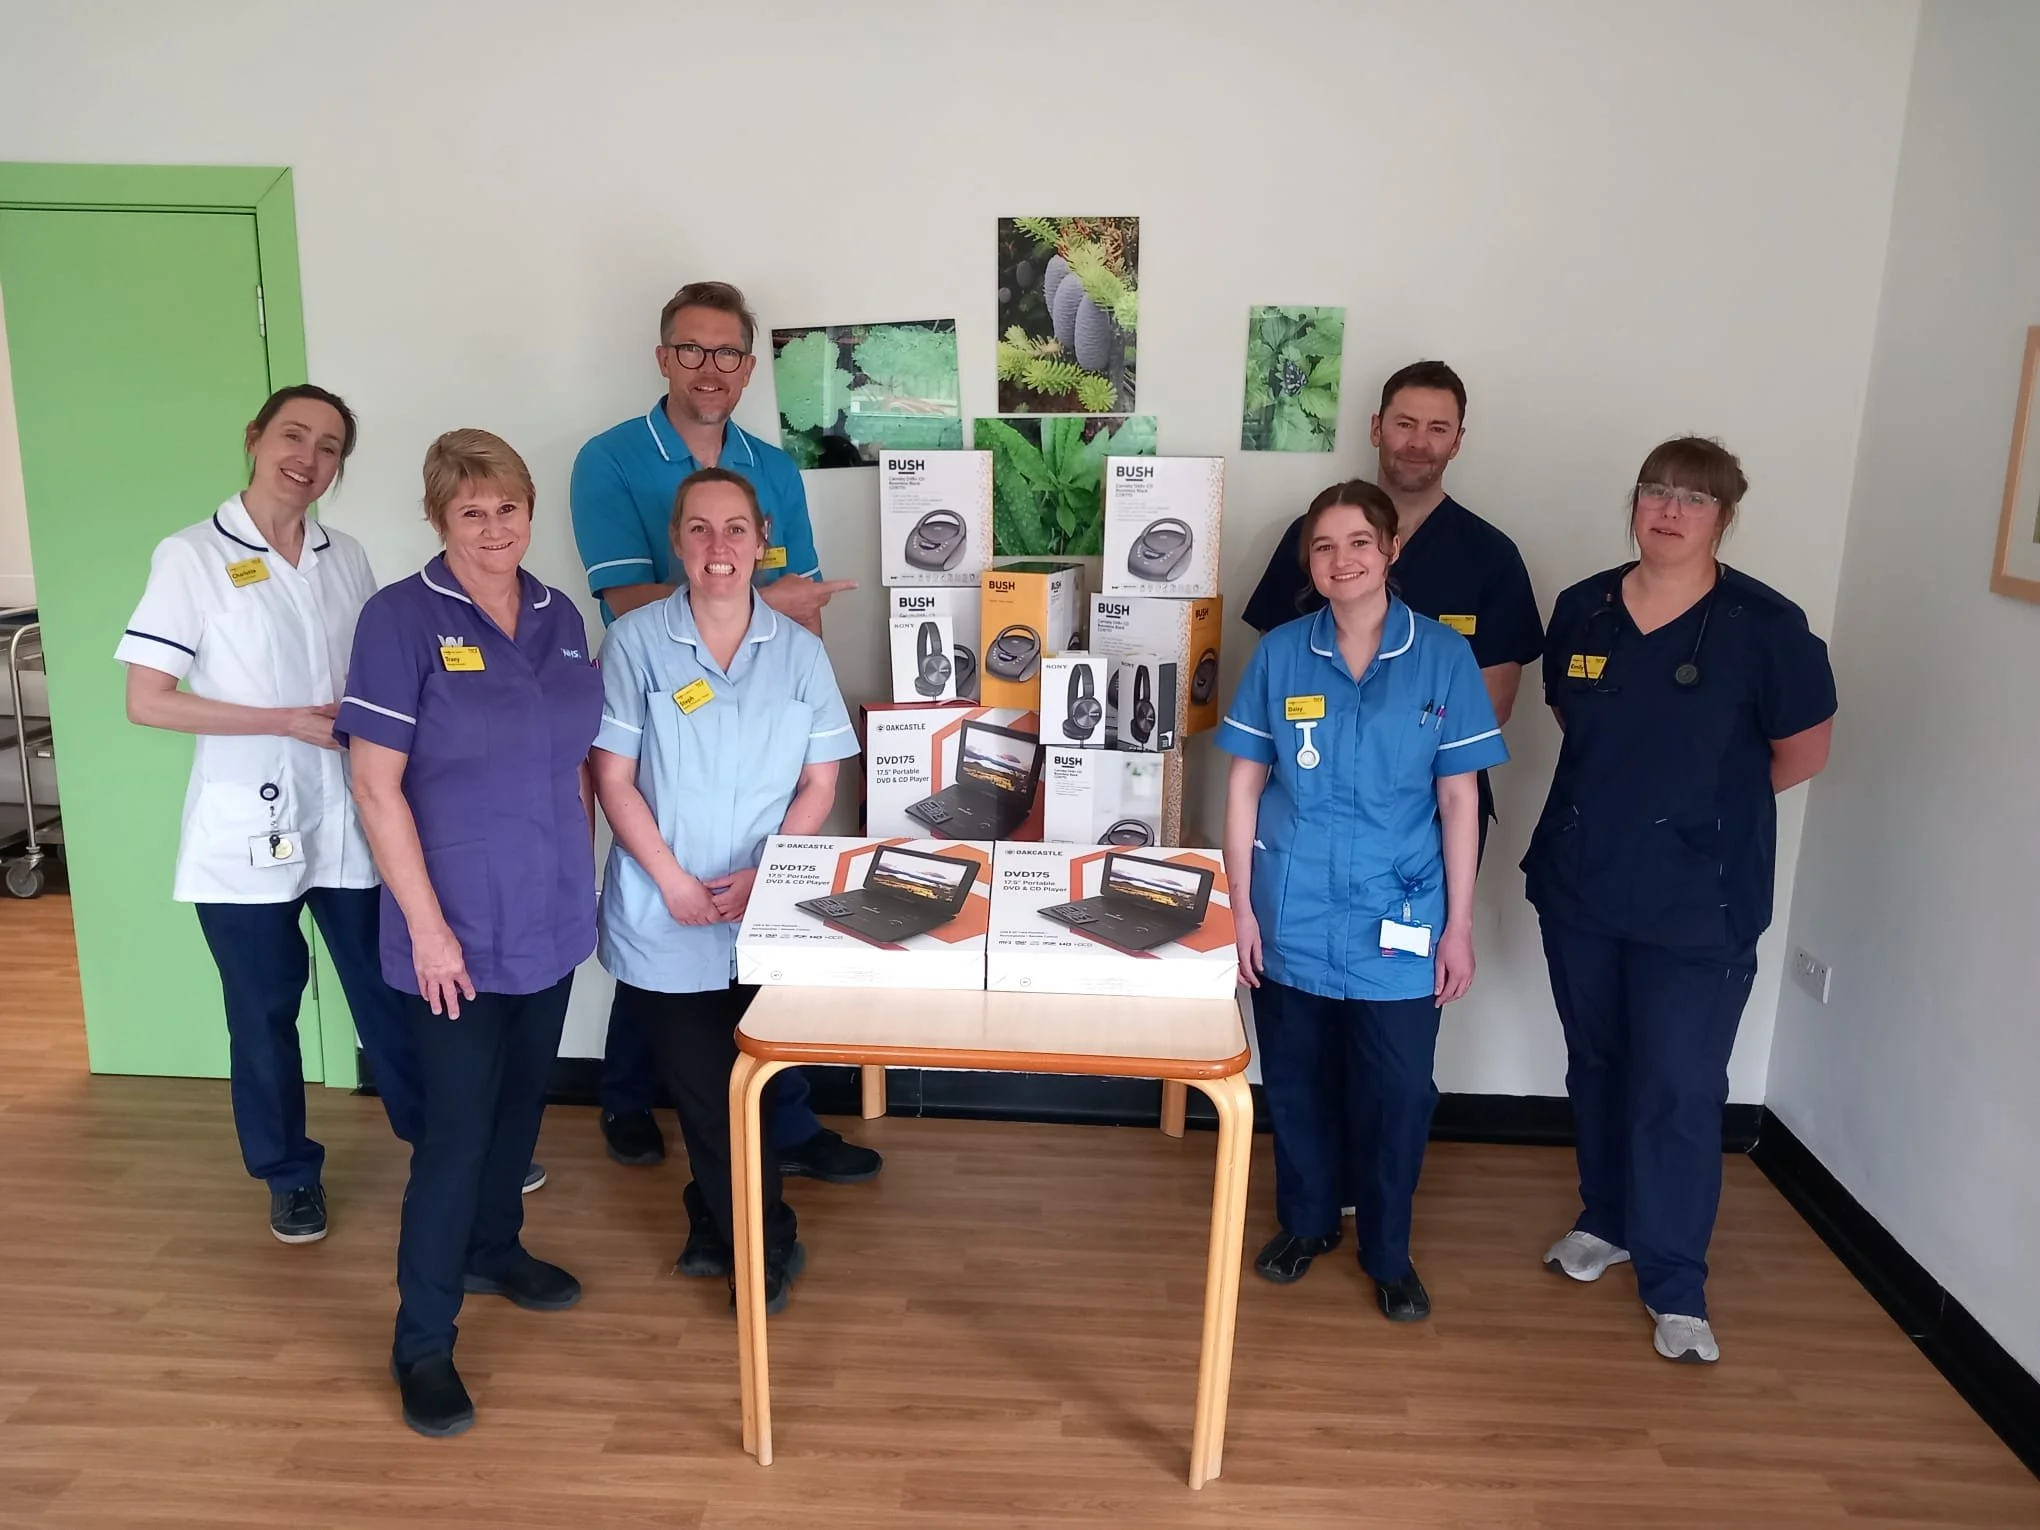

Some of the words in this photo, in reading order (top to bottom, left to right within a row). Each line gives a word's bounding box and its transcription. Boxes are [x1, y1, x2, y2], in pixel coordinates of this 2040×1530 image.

[888, 459, 925, 471] BUSH
[1116, 466, 1154, 478] BUSH
[988, 580, 1016, 591] BUSH
[898, 597, 935, 608] BUSH
[1098, 602, 1130, 617] BUSH
[885, 723, 927, 731] OAKCASTLE
[876, 755, 915, 765] DVD175
[1054, 755, 1083, 766] BUSH
[769, 864, 817, 872] DVD175
[1003, 870, 1050, 878] DVD175
